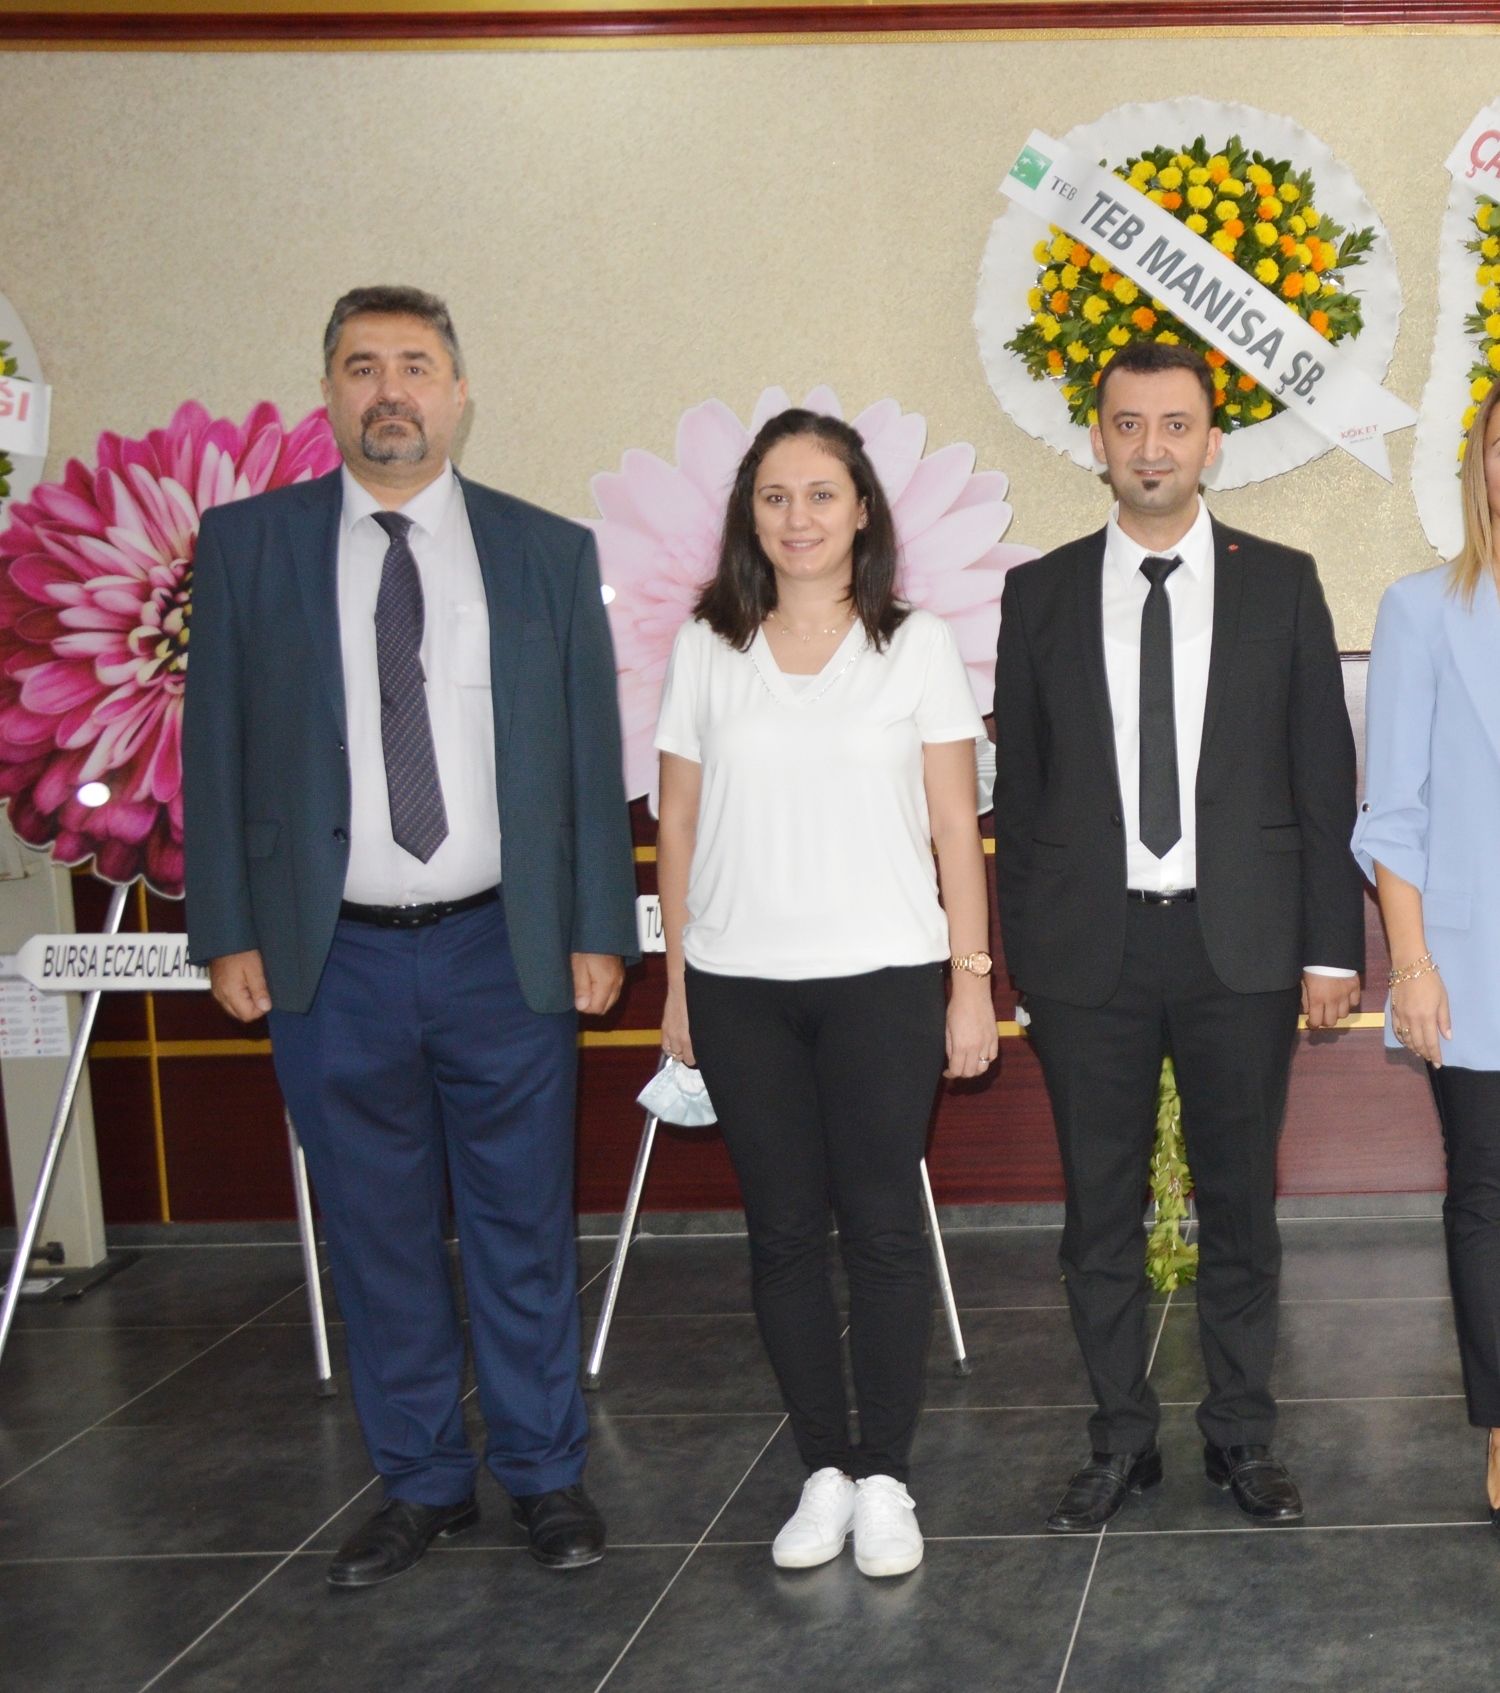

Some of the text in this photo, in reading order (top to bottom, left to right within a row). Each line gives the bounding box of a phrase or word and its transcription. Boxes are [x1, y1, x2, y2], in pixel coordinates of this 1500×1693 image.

[1052, 174, 1078, 202] TEB
[1079, 190, 1146, 252] TEB
[1135, 235, 1286, 370] MANİSA
[43, 945, 98, 978] BURSA
